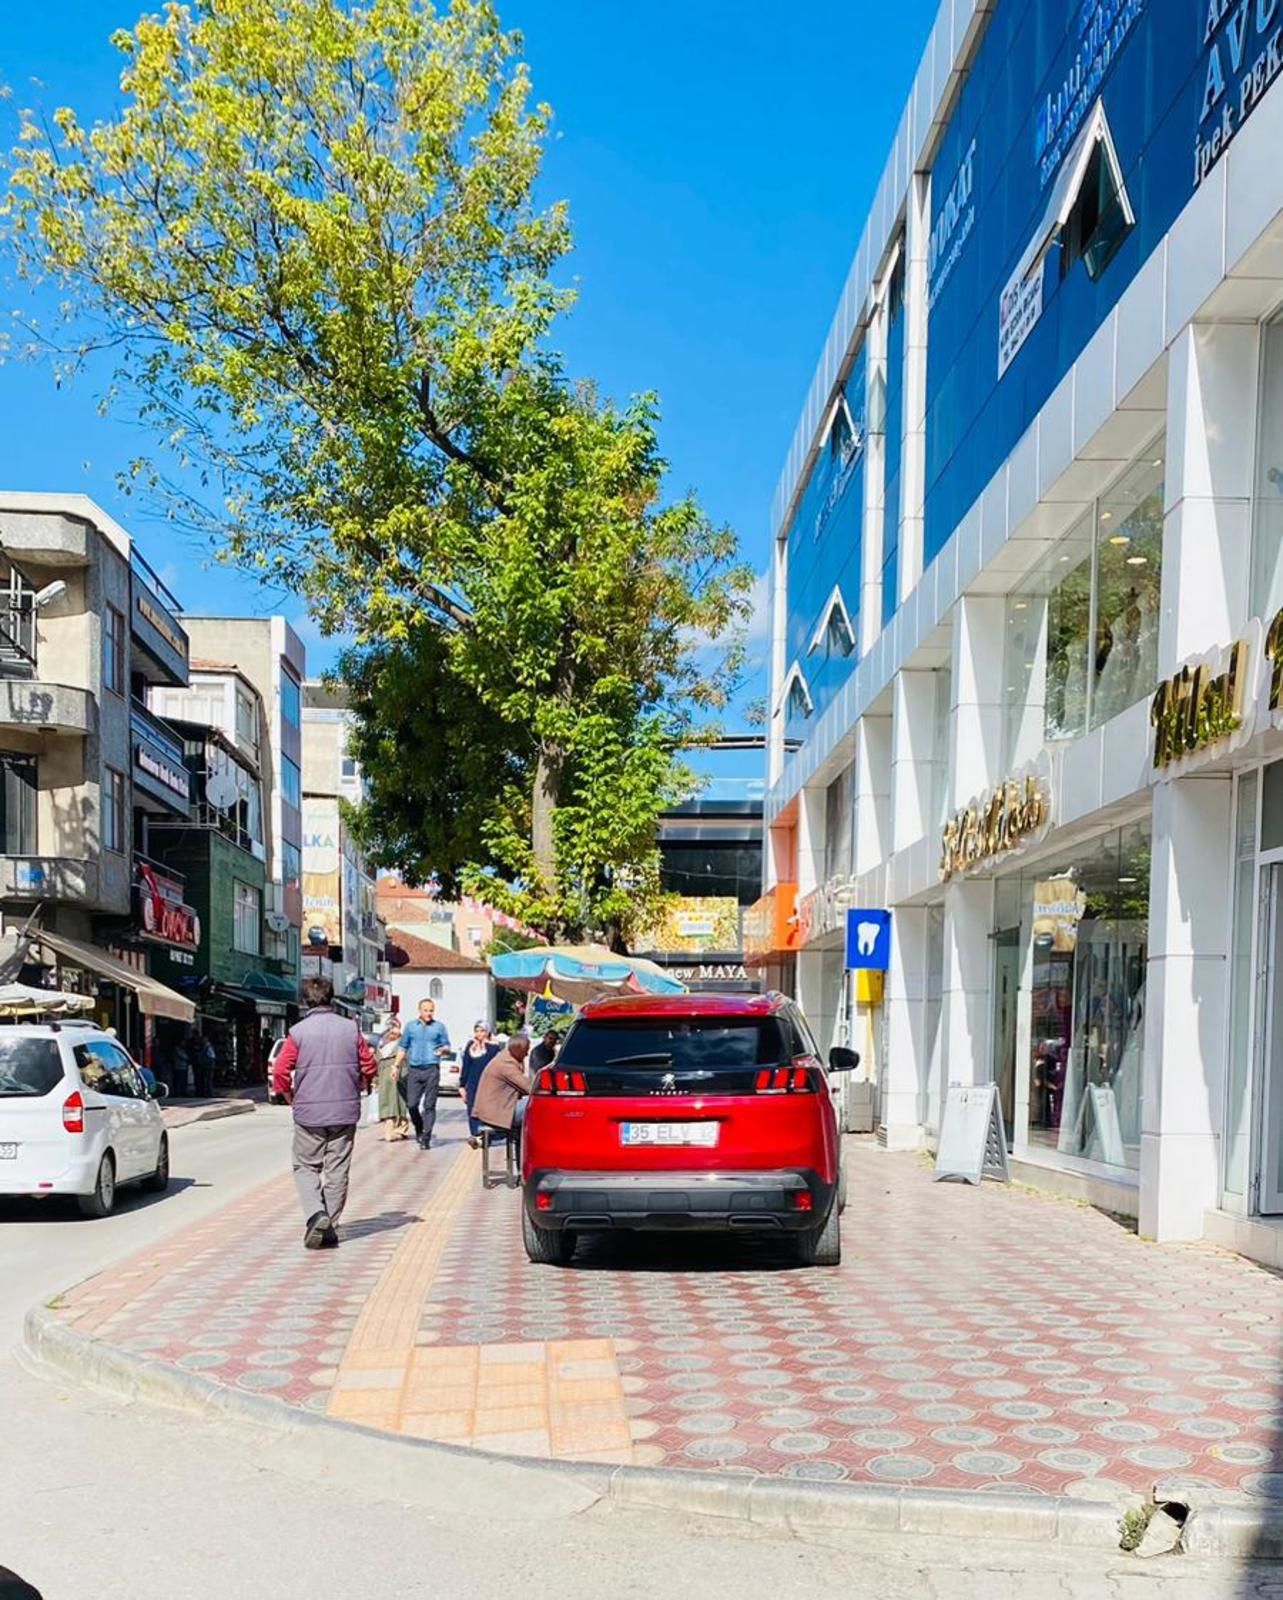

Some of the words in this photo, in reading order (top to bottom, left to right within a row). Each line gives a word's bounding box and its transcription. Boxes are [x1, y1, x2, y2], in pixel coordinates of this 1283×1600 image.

[1238, 25, 1283, 122] PEK
[699, 965, 747, 979] MAYA
[631, 1125, 650, 1139] 35
